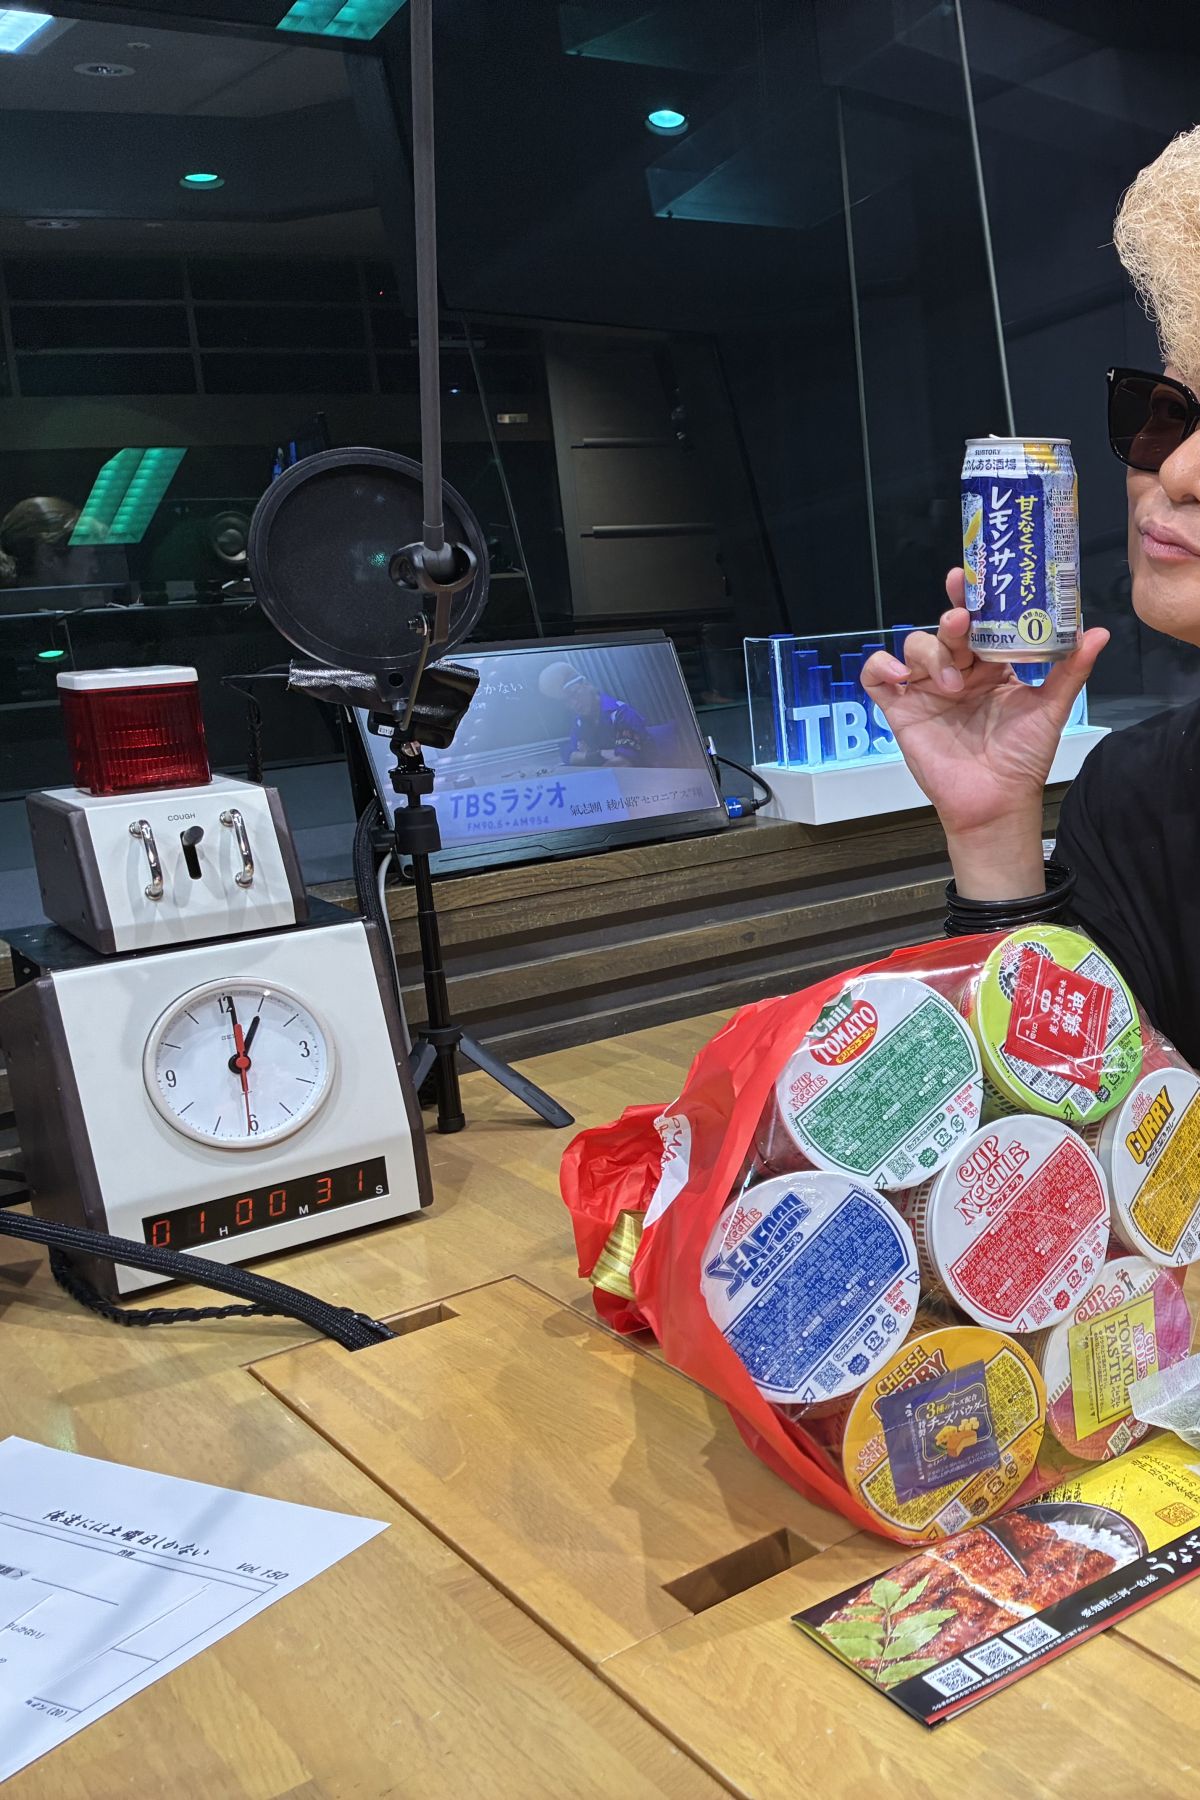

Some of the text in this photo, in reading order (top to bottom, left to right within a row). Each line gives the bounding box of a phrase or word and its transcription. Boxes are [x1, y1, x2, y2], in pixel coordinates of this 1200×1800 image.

[974, 448, 1002, 456] SUNTORY
[989, 486, 1016, 612] レモンサワー
[970, 632, 1016, 644] SUNTORY
[1027, 618, 1043, 641] 0
[167, 813, 196, 822] COUGH
[450, 781, 567, 819] TBSラジオ
[813, 1003, 852, 1038] Chili
[814, 1005, 876, 1063] TOMATO
[299, 1040, 311, 1058] 3
[166, 1069, 178, 1088] 9
[249, 1114, 259, 1132] 6
[1125, 1085, 1175, 1165] CURRY
[956, 1135, 998, 1188] CUP
[954, 1140, 1030, 1225] NOODLE
[219, 1225, 229, 1236] H
[299, 1204, 309, 1215] M
[375, 1185, 384, 1195] S
[705, 1192, 812, 1300] SEAFOOD
[898, 1302, 912, 1316] 3分
[1075, 1284, 1106, 1325] CUP
[1105, 1324, 1121, 1385] PASTE
[1117, 1313, 1133, 1362] TOM
[1144, 1333, 1155, 1364] CUP
[877, 1345, 927, 1395] CHEESE
[926, 1402, 988, 1433] チーズパウダー
[42, 1510, 210, 1557] 俺達には土曜日しかない
[260, 1566, 289, 1581] 150
